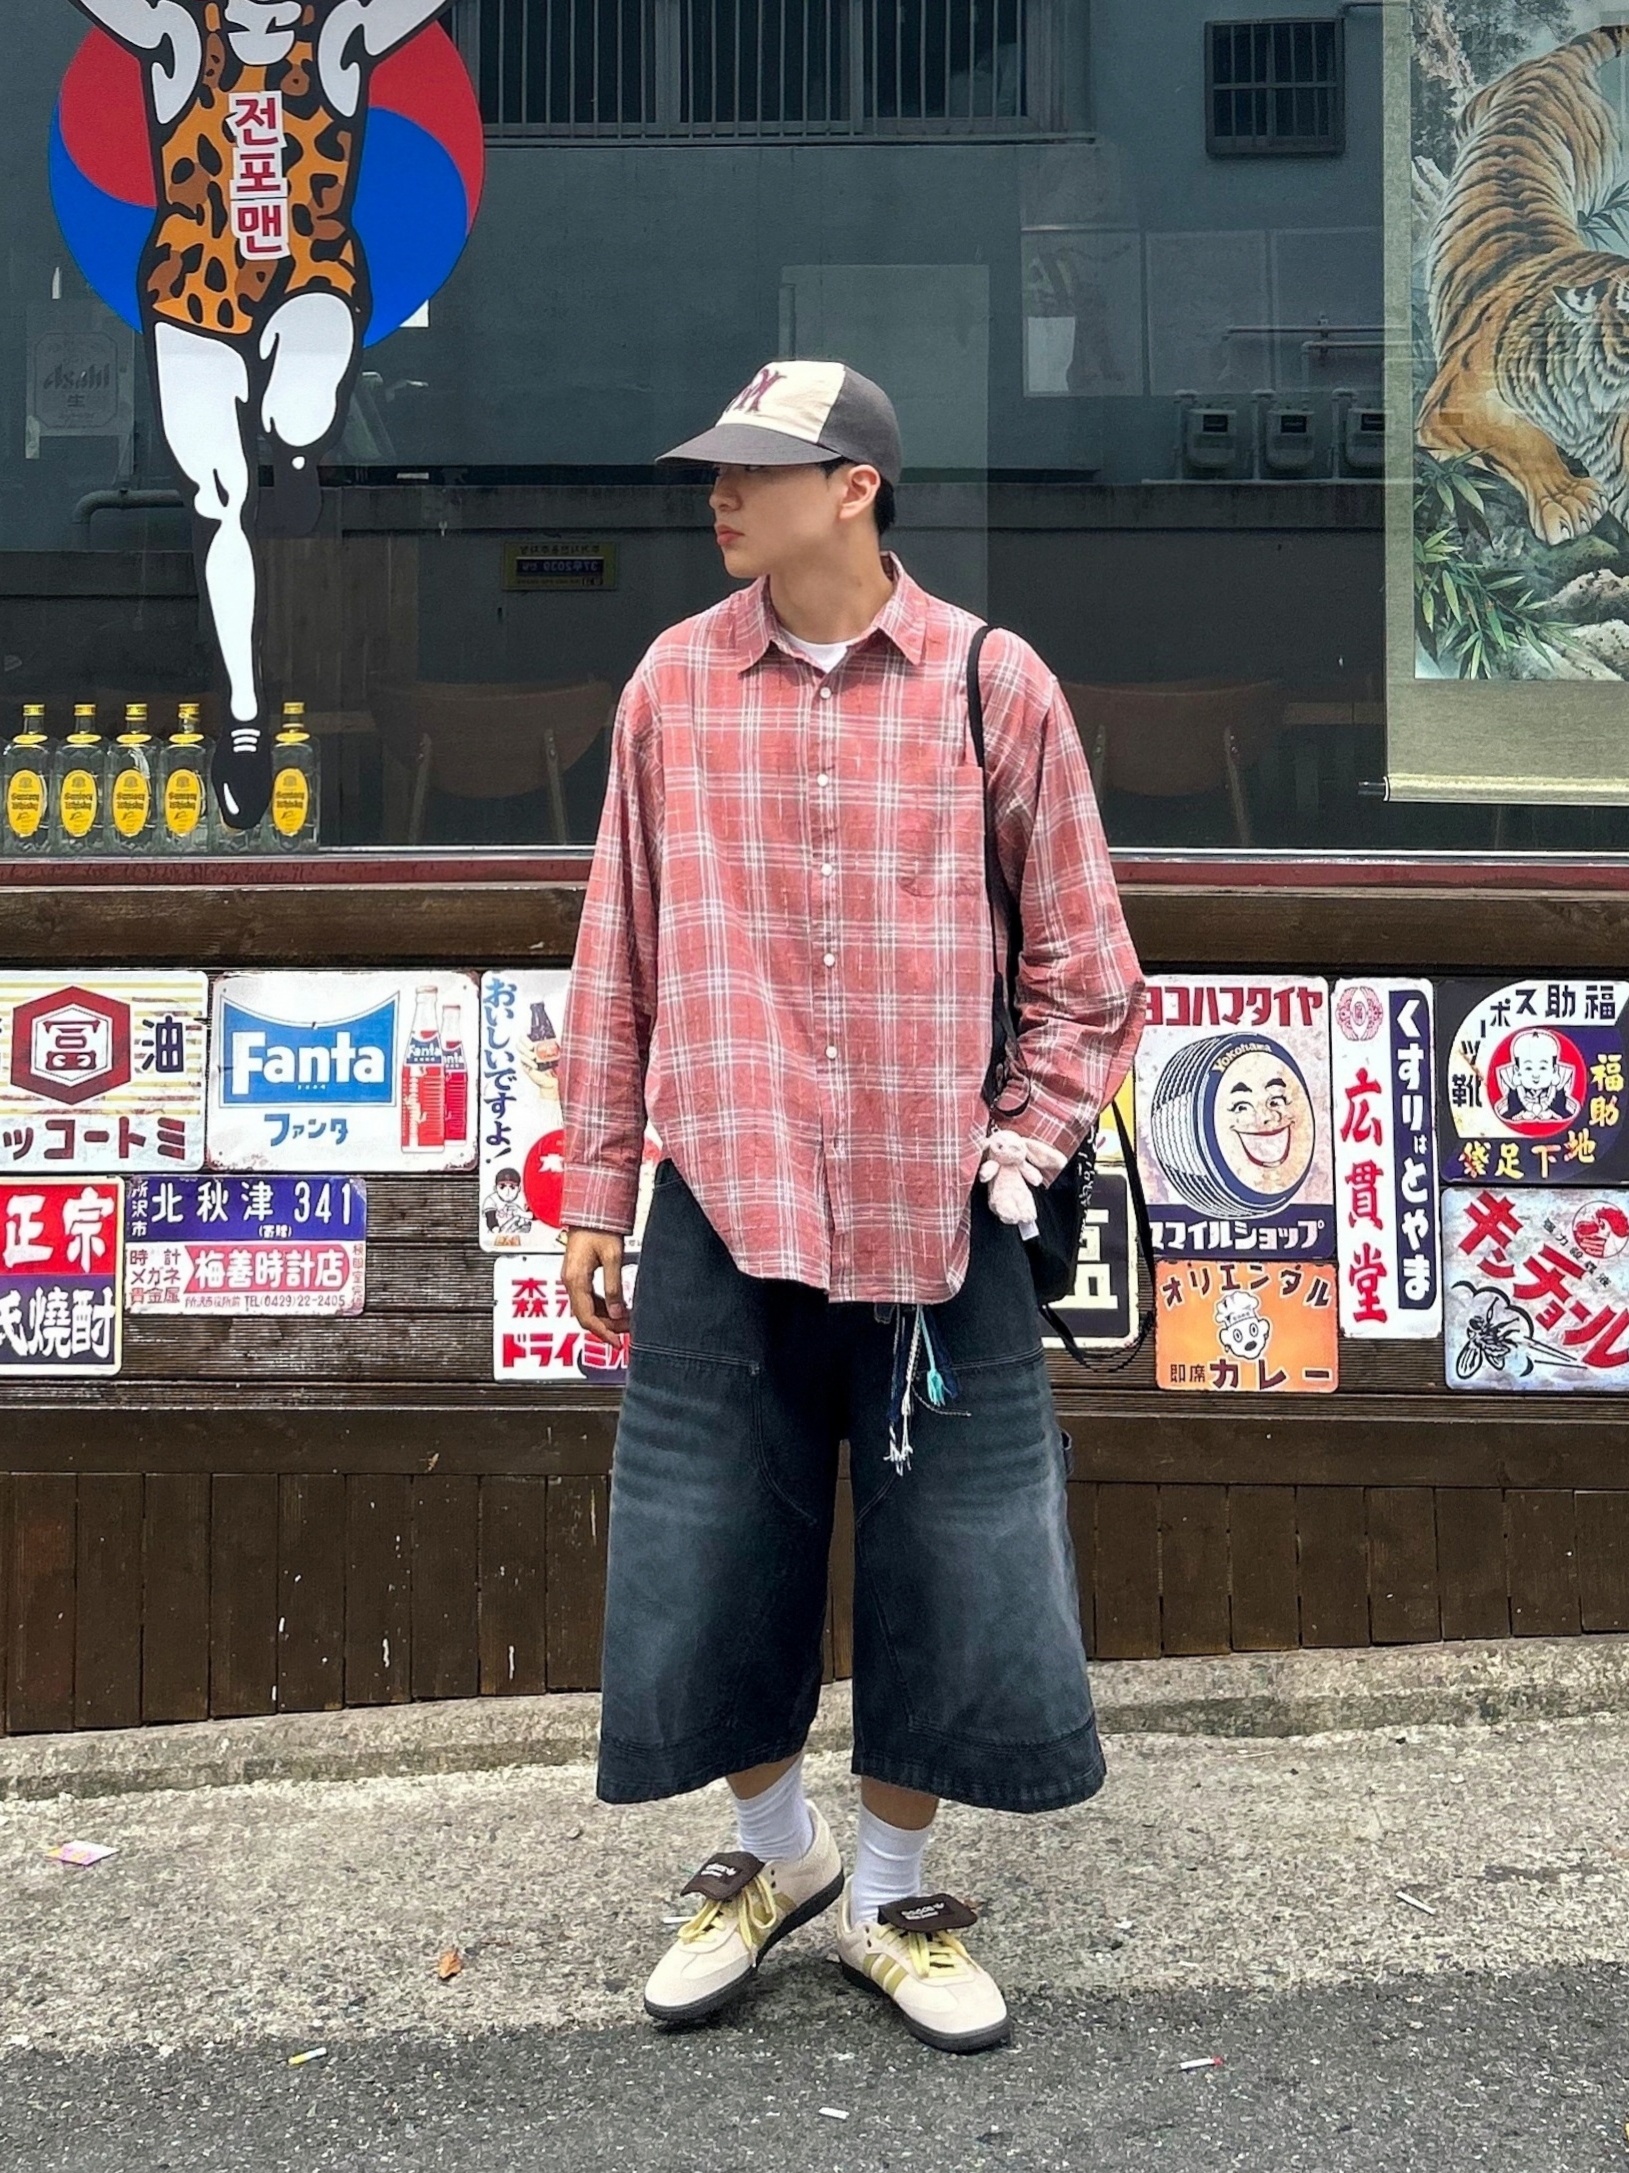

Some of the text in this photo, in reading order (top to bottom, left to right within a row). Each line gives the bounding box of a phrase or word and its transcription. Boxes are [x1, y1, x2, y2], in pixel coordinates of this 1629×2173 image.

[235, 97, 283, 253] 전포맨
[43, 363, 110, 390] Asahi
[1145, 986, 1323, 1026] ヨコハマタイヤ
[142, 1016, 184, 1073] 油
[232, 1031, 385, 1095] Fanta
[3, 1116, 186, 1161] ッコートミ
[264, 1113, 349, 1147] ファンタ
[1397, 1000, 1430, 1301] くすりはとやま
[151, 1181, 351, 1226] 北秋津 341
[1339, 1067, 1388, 1323] 広貫堂
[3, 1186, 115, 1274] 正宗
[131, 1266, 181, 1286] メガネ
